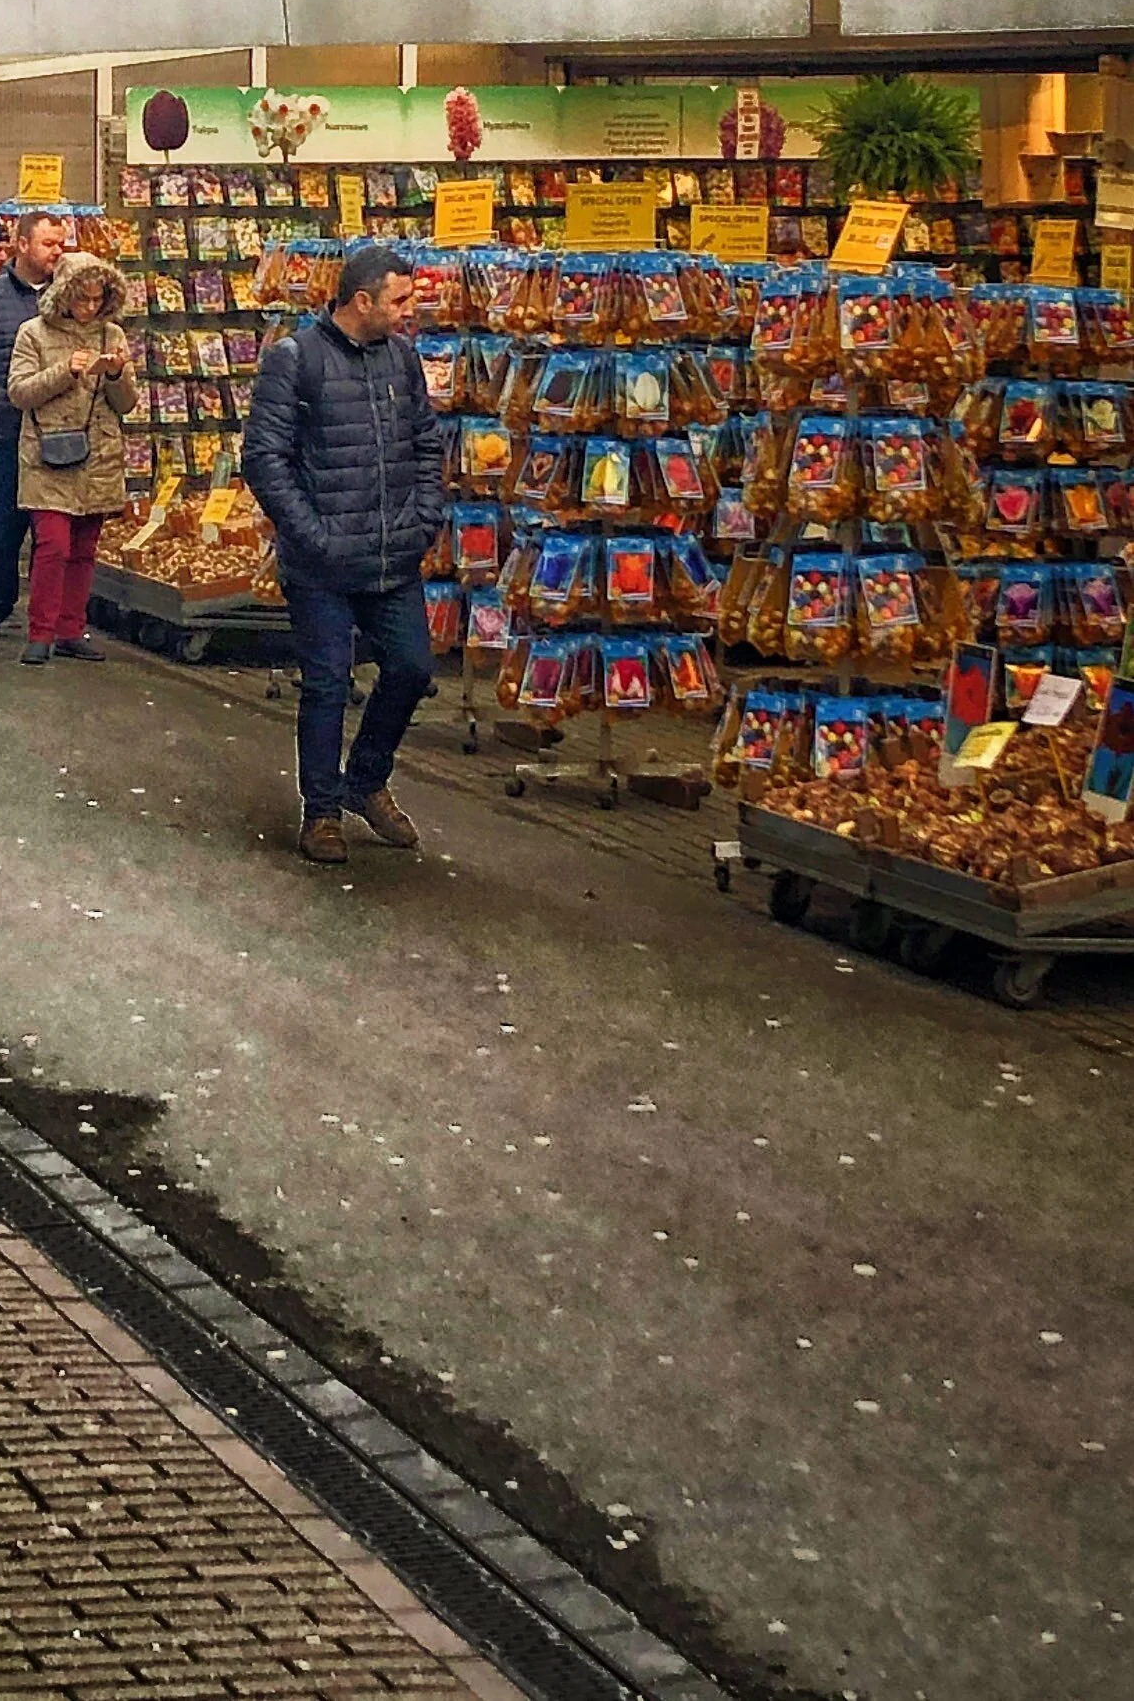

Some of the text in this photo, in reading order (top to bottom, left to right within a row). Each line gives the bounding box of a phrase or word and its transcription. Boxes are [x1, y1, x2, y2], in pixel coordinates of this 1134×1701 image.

[580, 196, 642, 206] SPECIAL OFFER
[699, 215, 759, 223] SPECIAL OFFER
